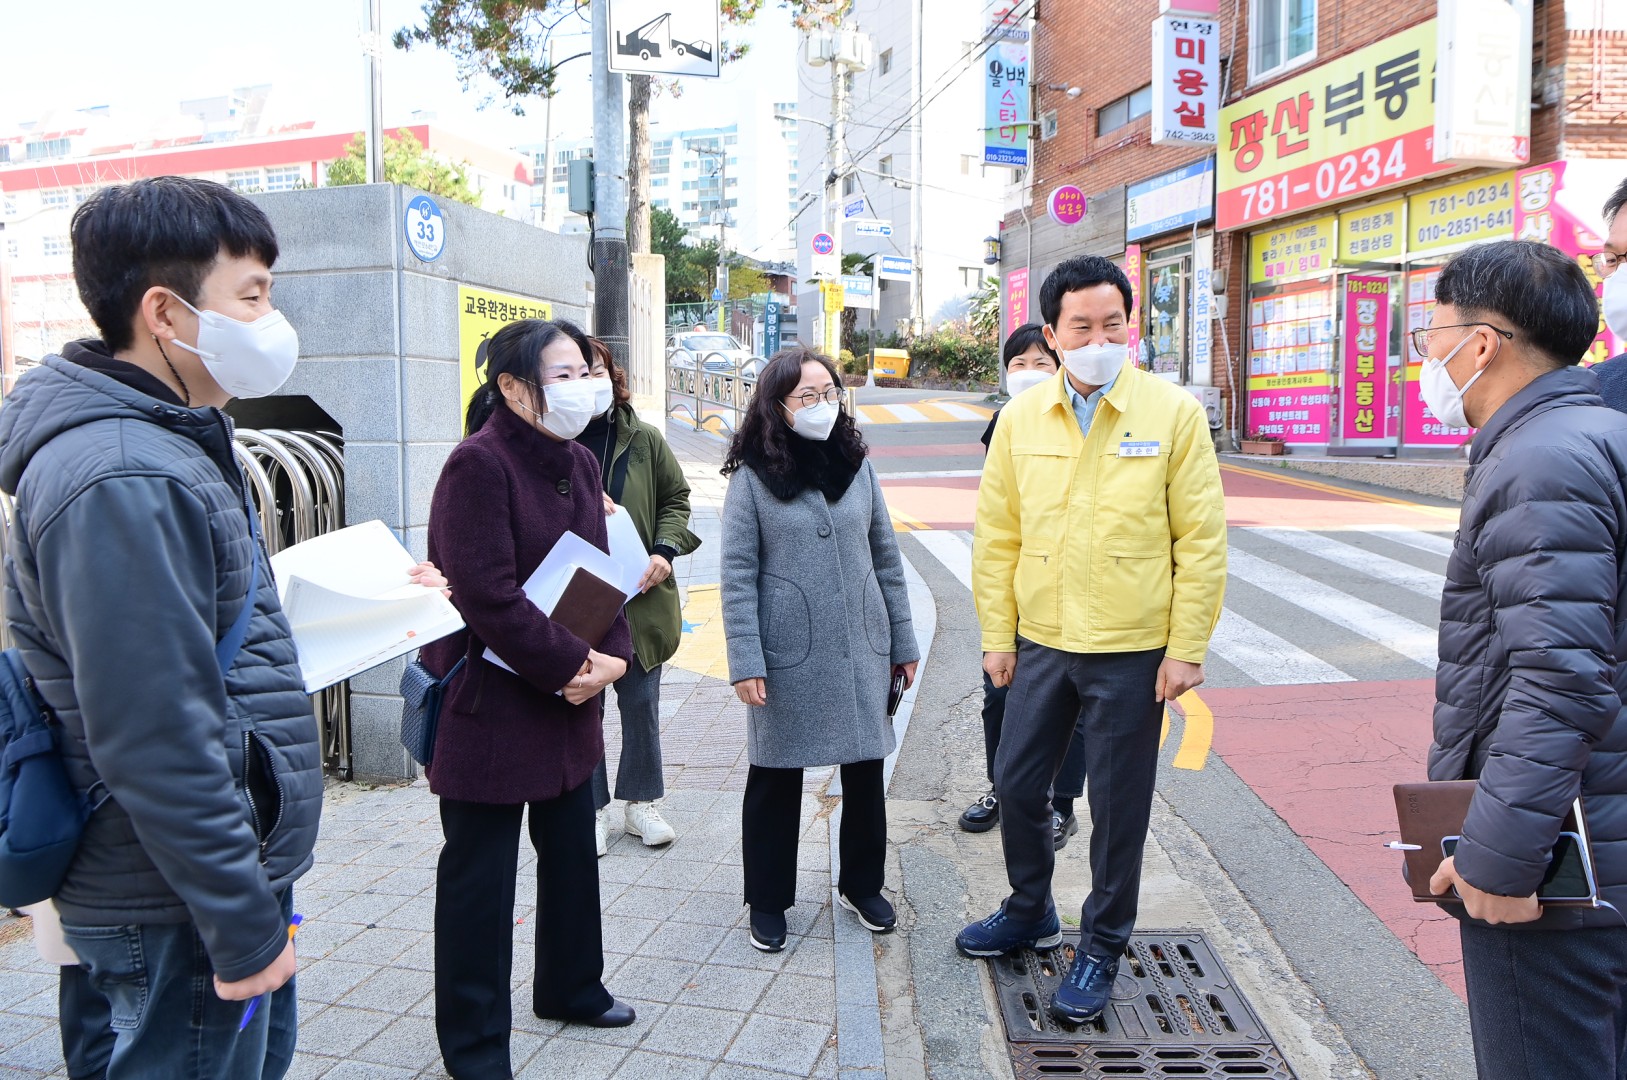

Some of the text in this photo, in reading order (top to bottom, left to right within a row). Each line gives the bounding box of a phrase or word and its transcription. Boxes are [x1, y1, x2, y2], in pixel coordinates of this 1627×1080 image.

[1173, 37, 1208, 128] 미용실
[1000, 89, 1016, 142] 스터디
[1165, 130, 1215, 141] 742-3843
[1241, 138, 1406, 221] 781-0234
[1060, 192, 1080, 201] 아이
[1429, 182, 1509, 215] 781-0234
[1057, 204, 1083, 217] 브로우
[417, 221, 434, 242] 33
[1349, 233, 1393, 254] 친절상담
[1298, 254, 1320, 271] 임대
[1348, 280, 1388, 295] 781-0234
[767, 314, 777, 336] 명유
[1195, 267, 1210, 365] 맞춤전문
[1355, 298, 1378, 433] 장산부동산
[1408, 794, 1420, 814] 2021
